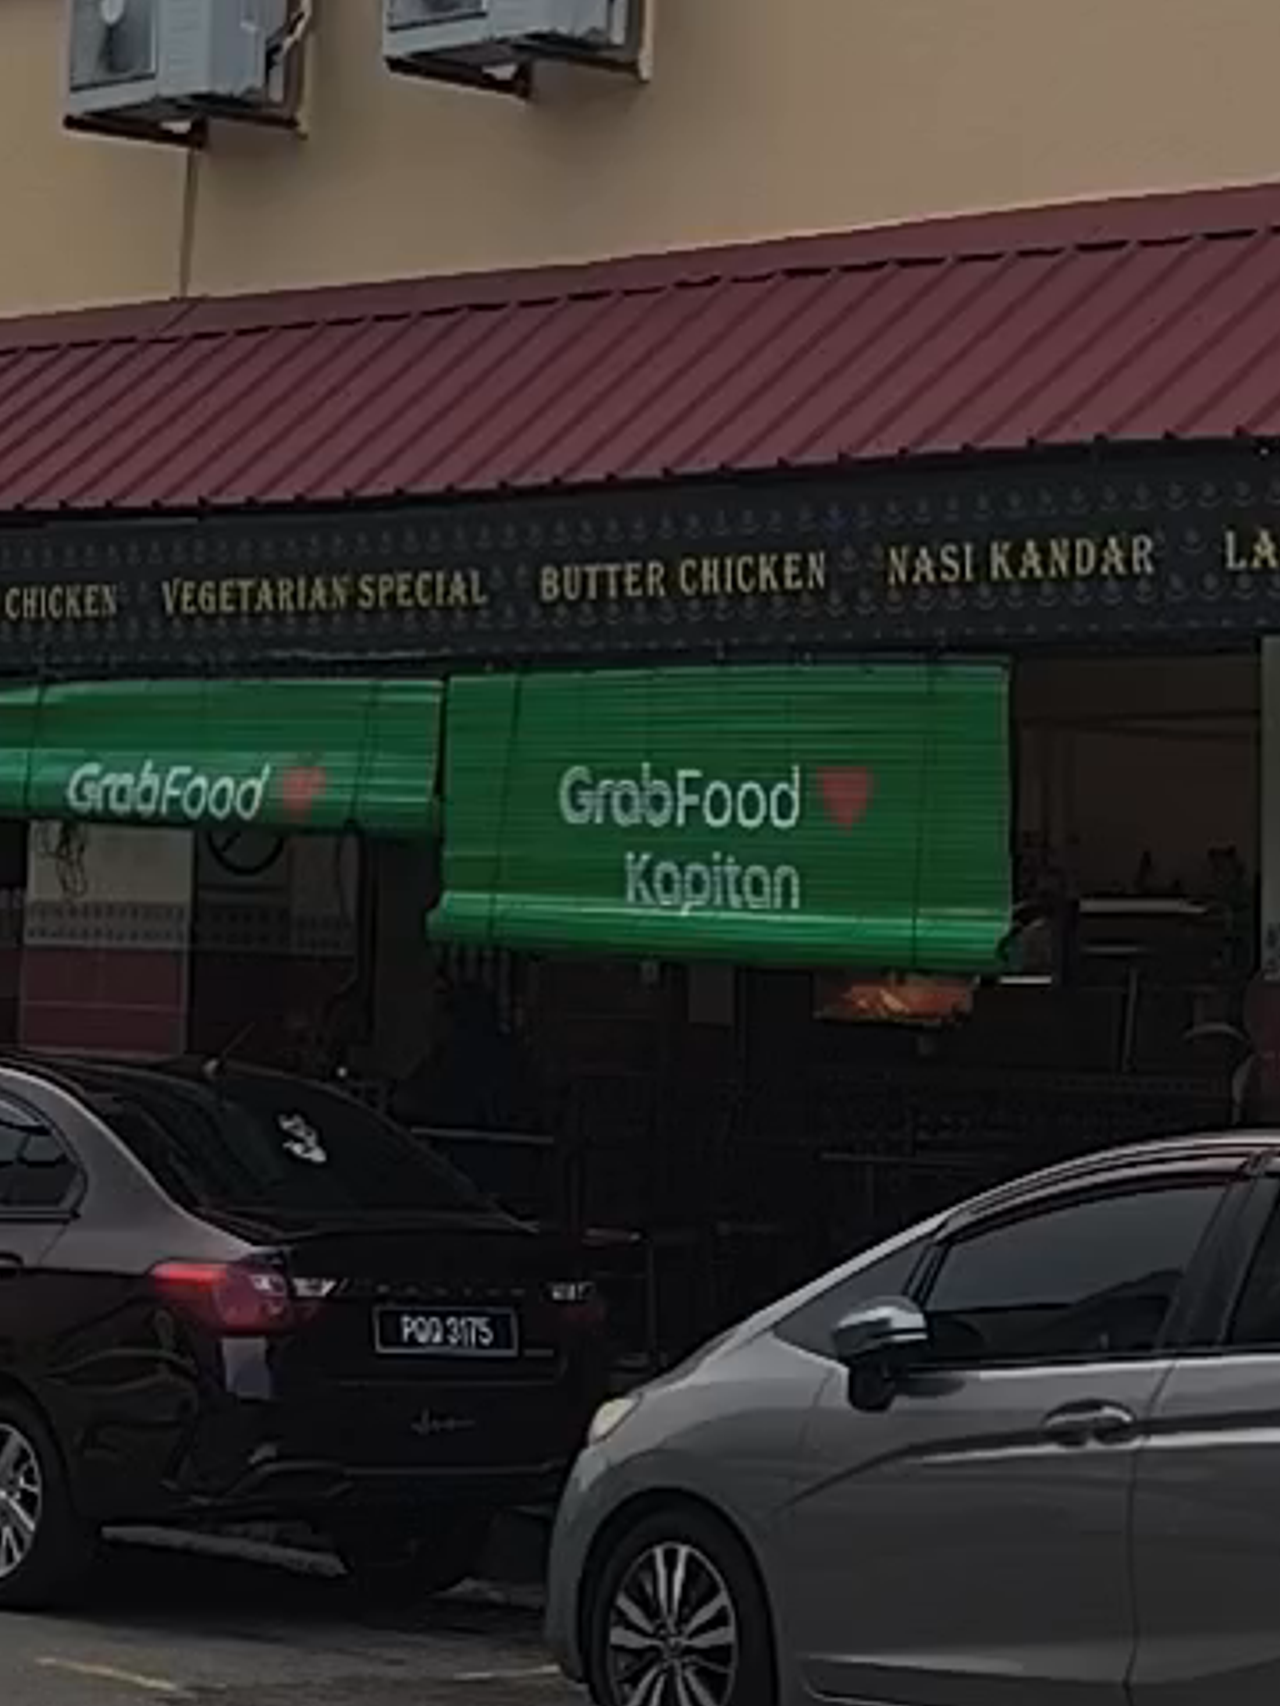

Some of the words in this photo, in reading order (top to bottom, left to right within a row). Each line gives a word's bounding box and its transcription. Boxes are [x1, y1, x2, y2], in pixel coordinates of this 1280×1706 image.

[887, 542, 975, 586] NASI
[989, 534, 1155, 580] KANDAR
[1223, 527, 1279, 570] LA
[4, 582, 118, 619] CHICKEN
[161, 575, 349, 616] VEGETARIAN
[357, 570, 489, 609] SPECIAL
[539, 560, 667, 602] BUTTER
[679, 550, 826, 596] CHICKEN
[67, 760, 271, 822] GrabFood
[558, 761, 802, 833] GrabFood
[623, 850, 801, 916] Kapitan
